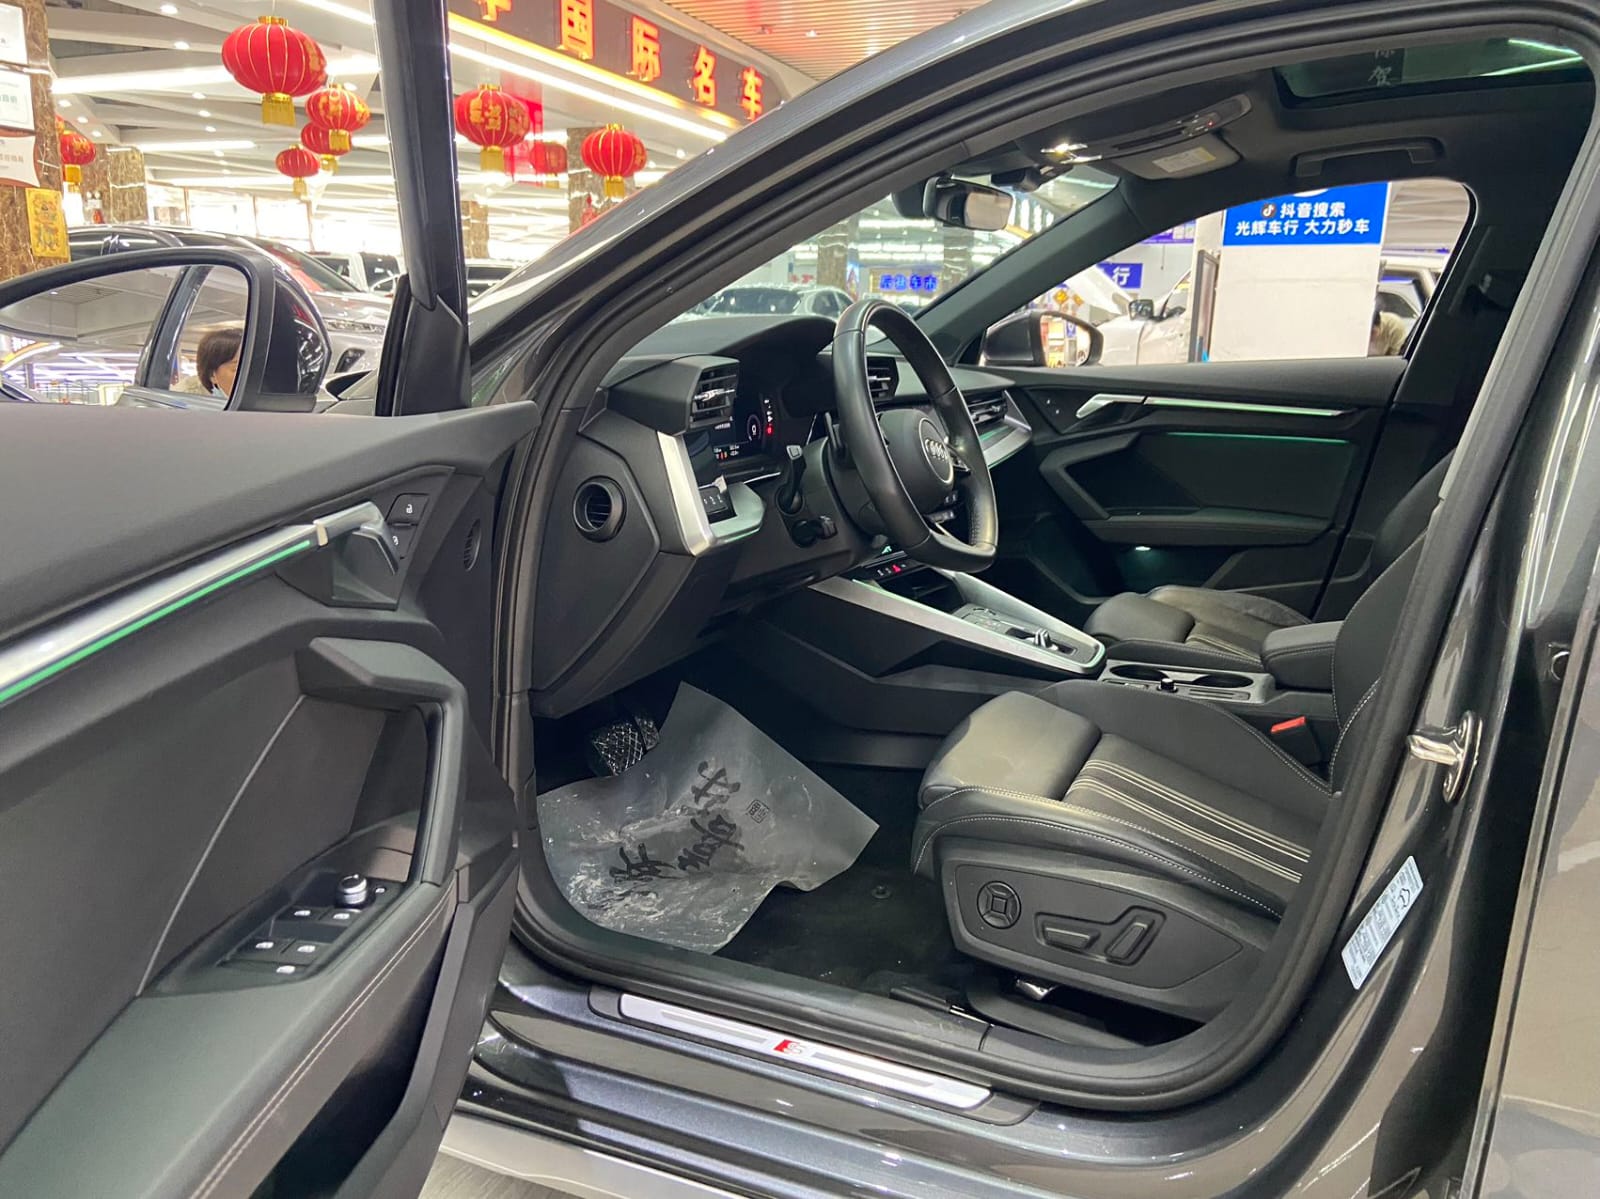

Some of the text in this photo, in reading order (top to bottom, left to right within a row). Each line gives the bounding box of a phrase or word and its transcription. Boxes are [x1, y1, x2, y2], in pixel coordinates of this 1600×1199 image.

[1280, 202, 1346, 219] 抖音搜索
[1235, 218, 1370, 236] 光辉车行 大力秒车
[1112, 266, 1130, 286] 行
